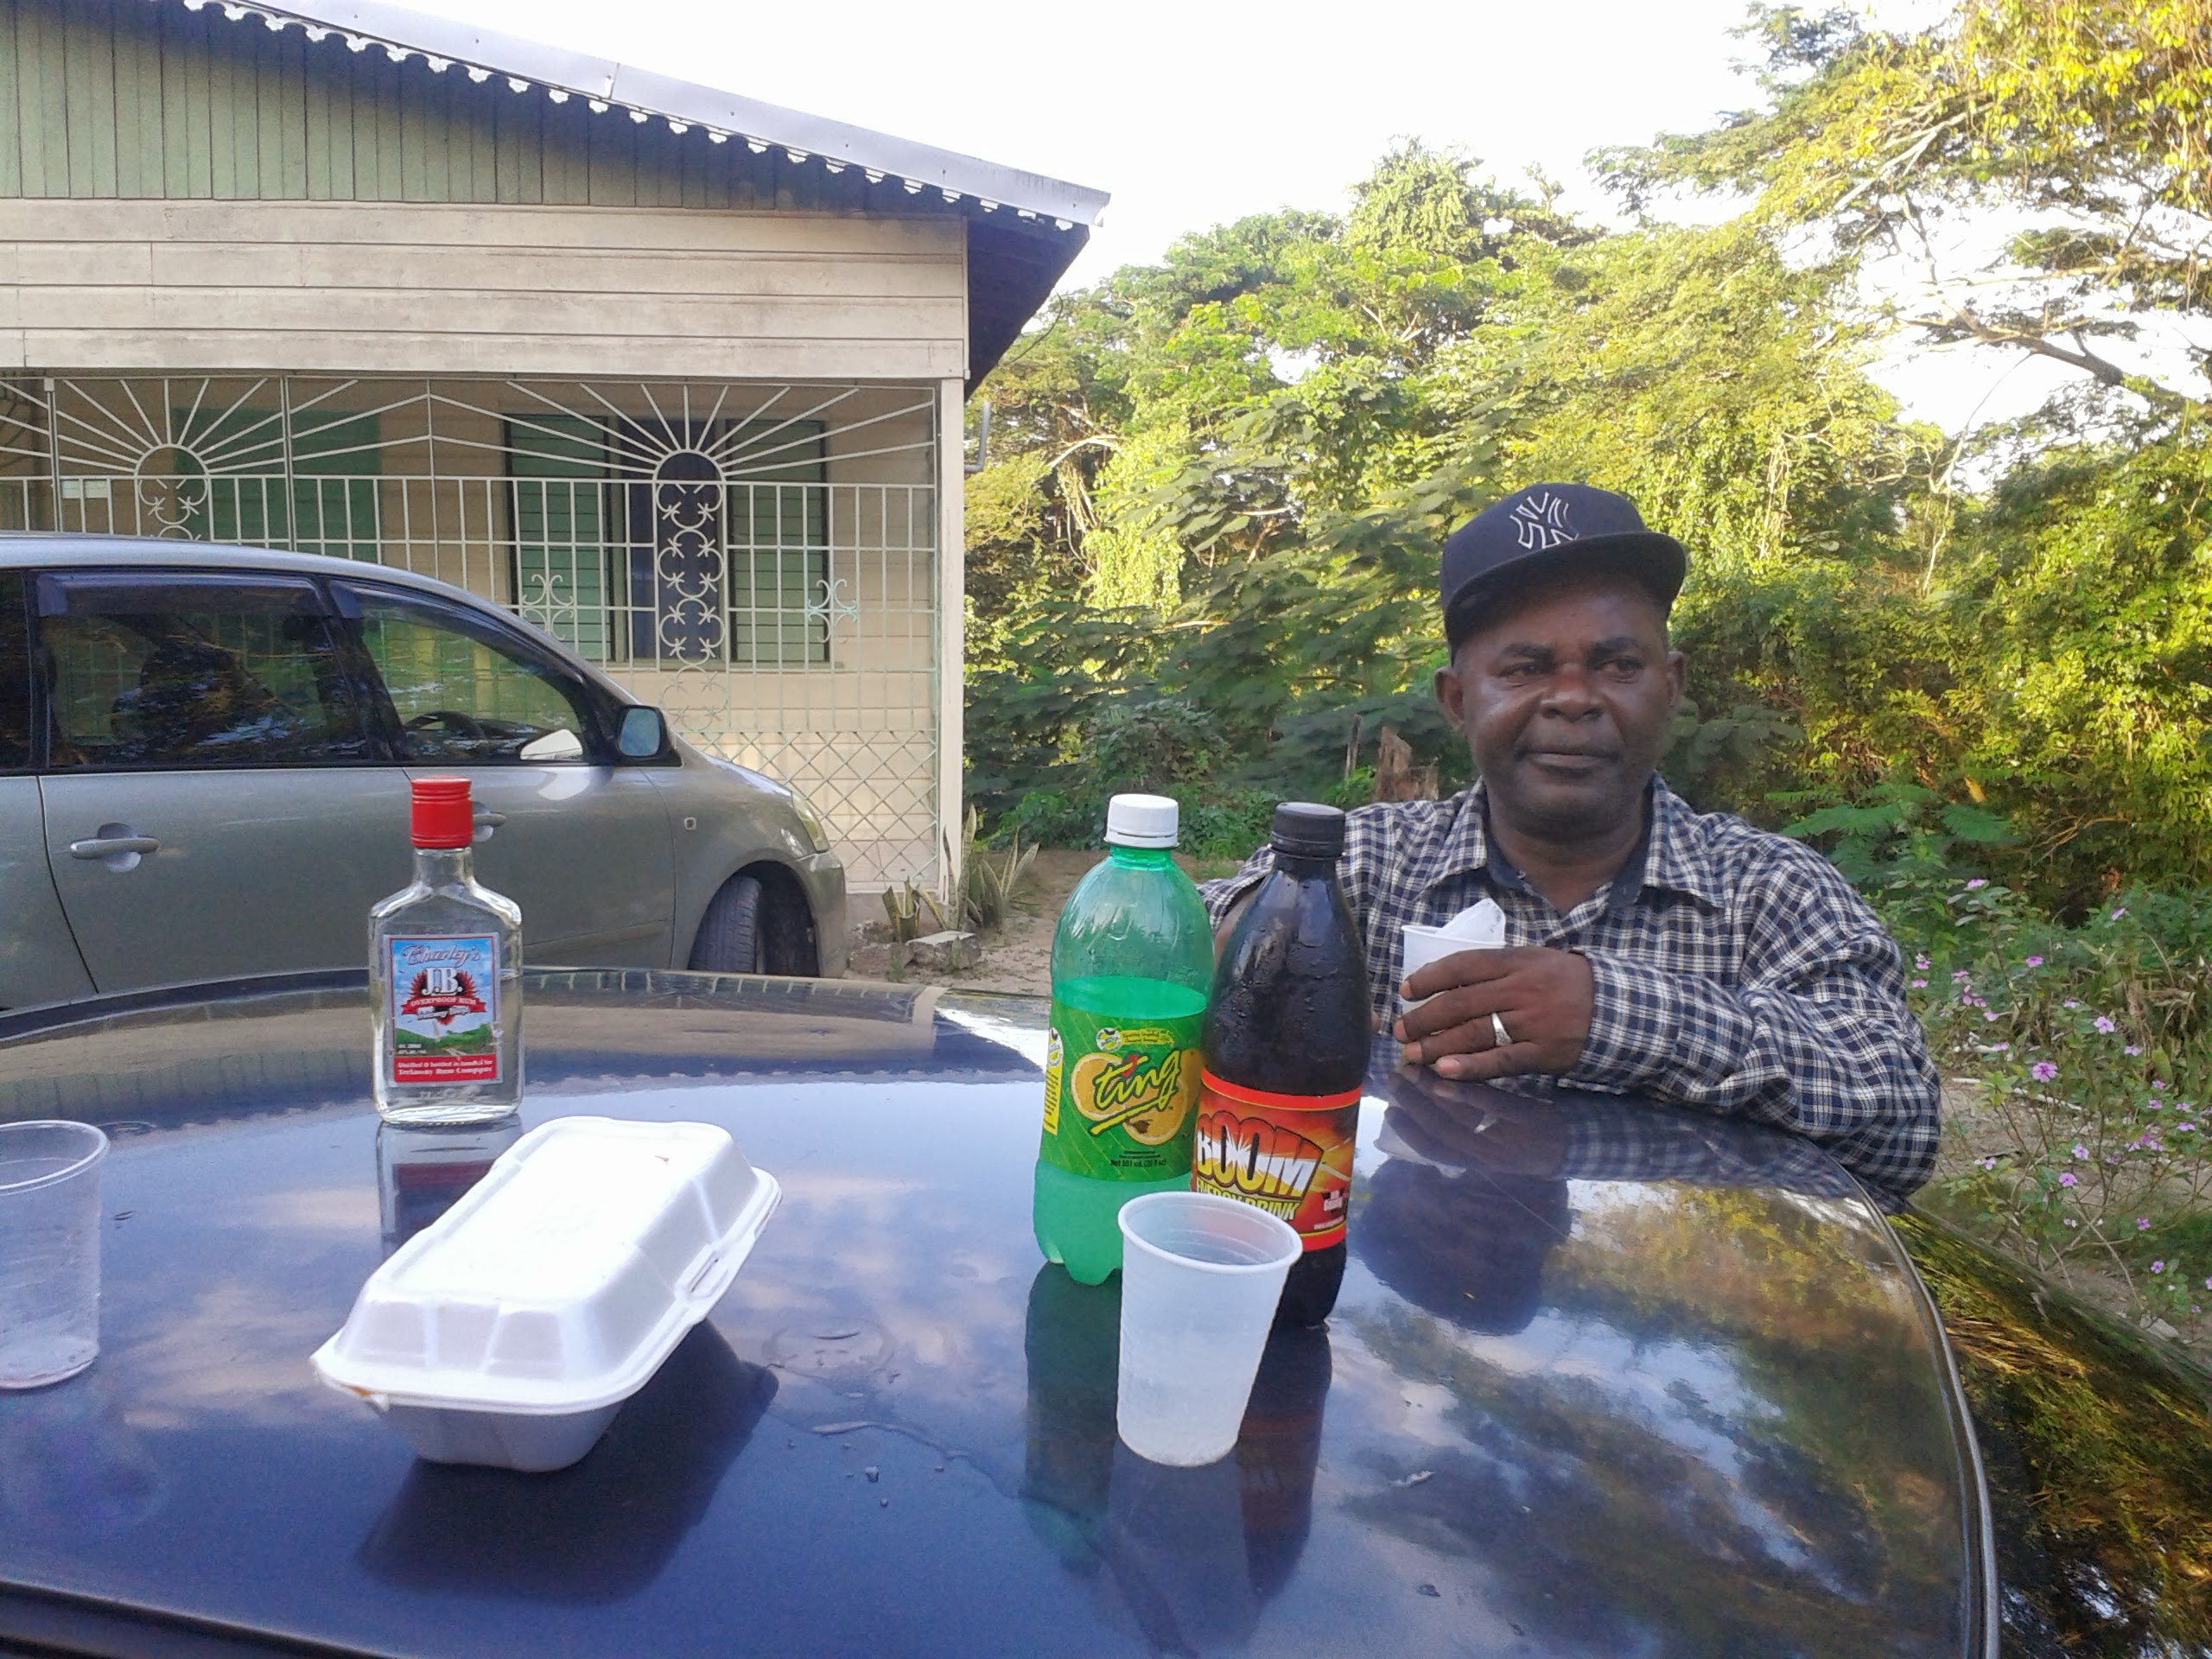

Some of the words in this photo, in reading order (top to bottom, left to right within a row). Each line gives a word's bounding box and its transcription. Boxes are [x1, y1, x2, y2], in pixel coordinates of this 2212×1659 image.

[401, 944, 480, 968] Charley's
[421, 967, 463, 995] J.B.
[1197, 1111, 1323, 1198] BOOM
